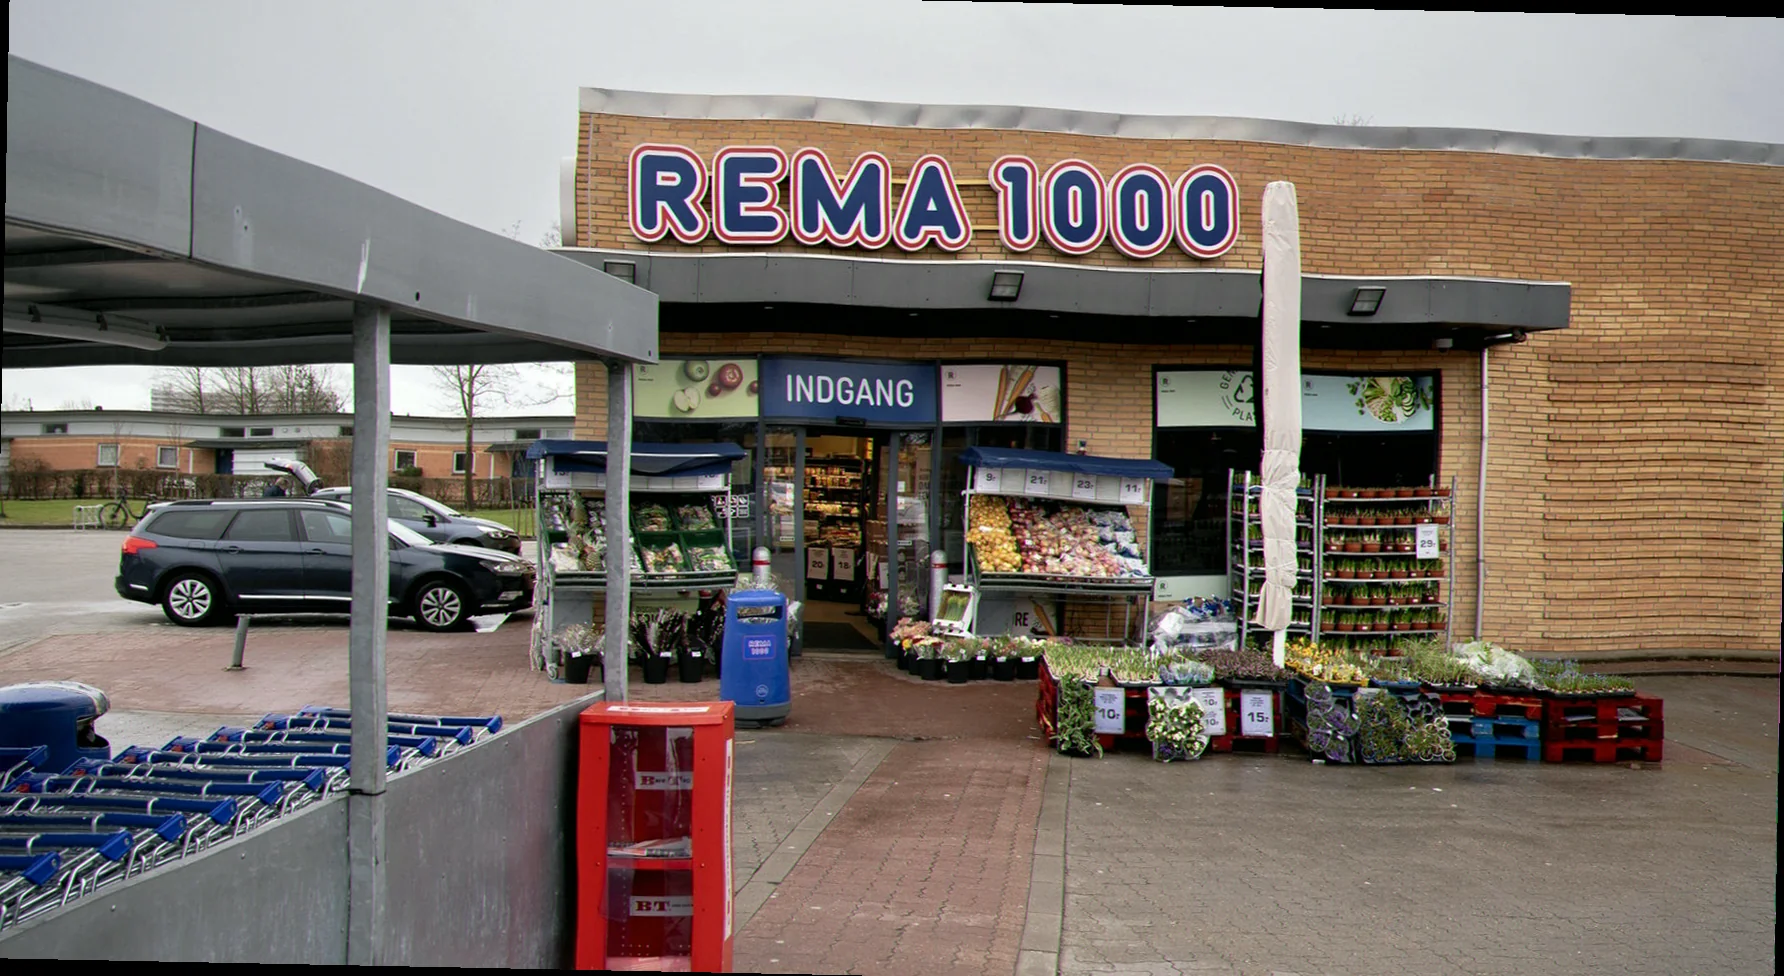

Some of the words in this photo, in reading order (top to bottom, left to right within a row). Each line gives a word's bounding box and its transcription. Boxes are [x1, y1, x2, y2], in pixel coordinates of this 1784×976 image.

[628, 143, 973, 251] REMA
[988, 154, 1240, 260] 1000
[786, 374, 914, 408] INDGANG
